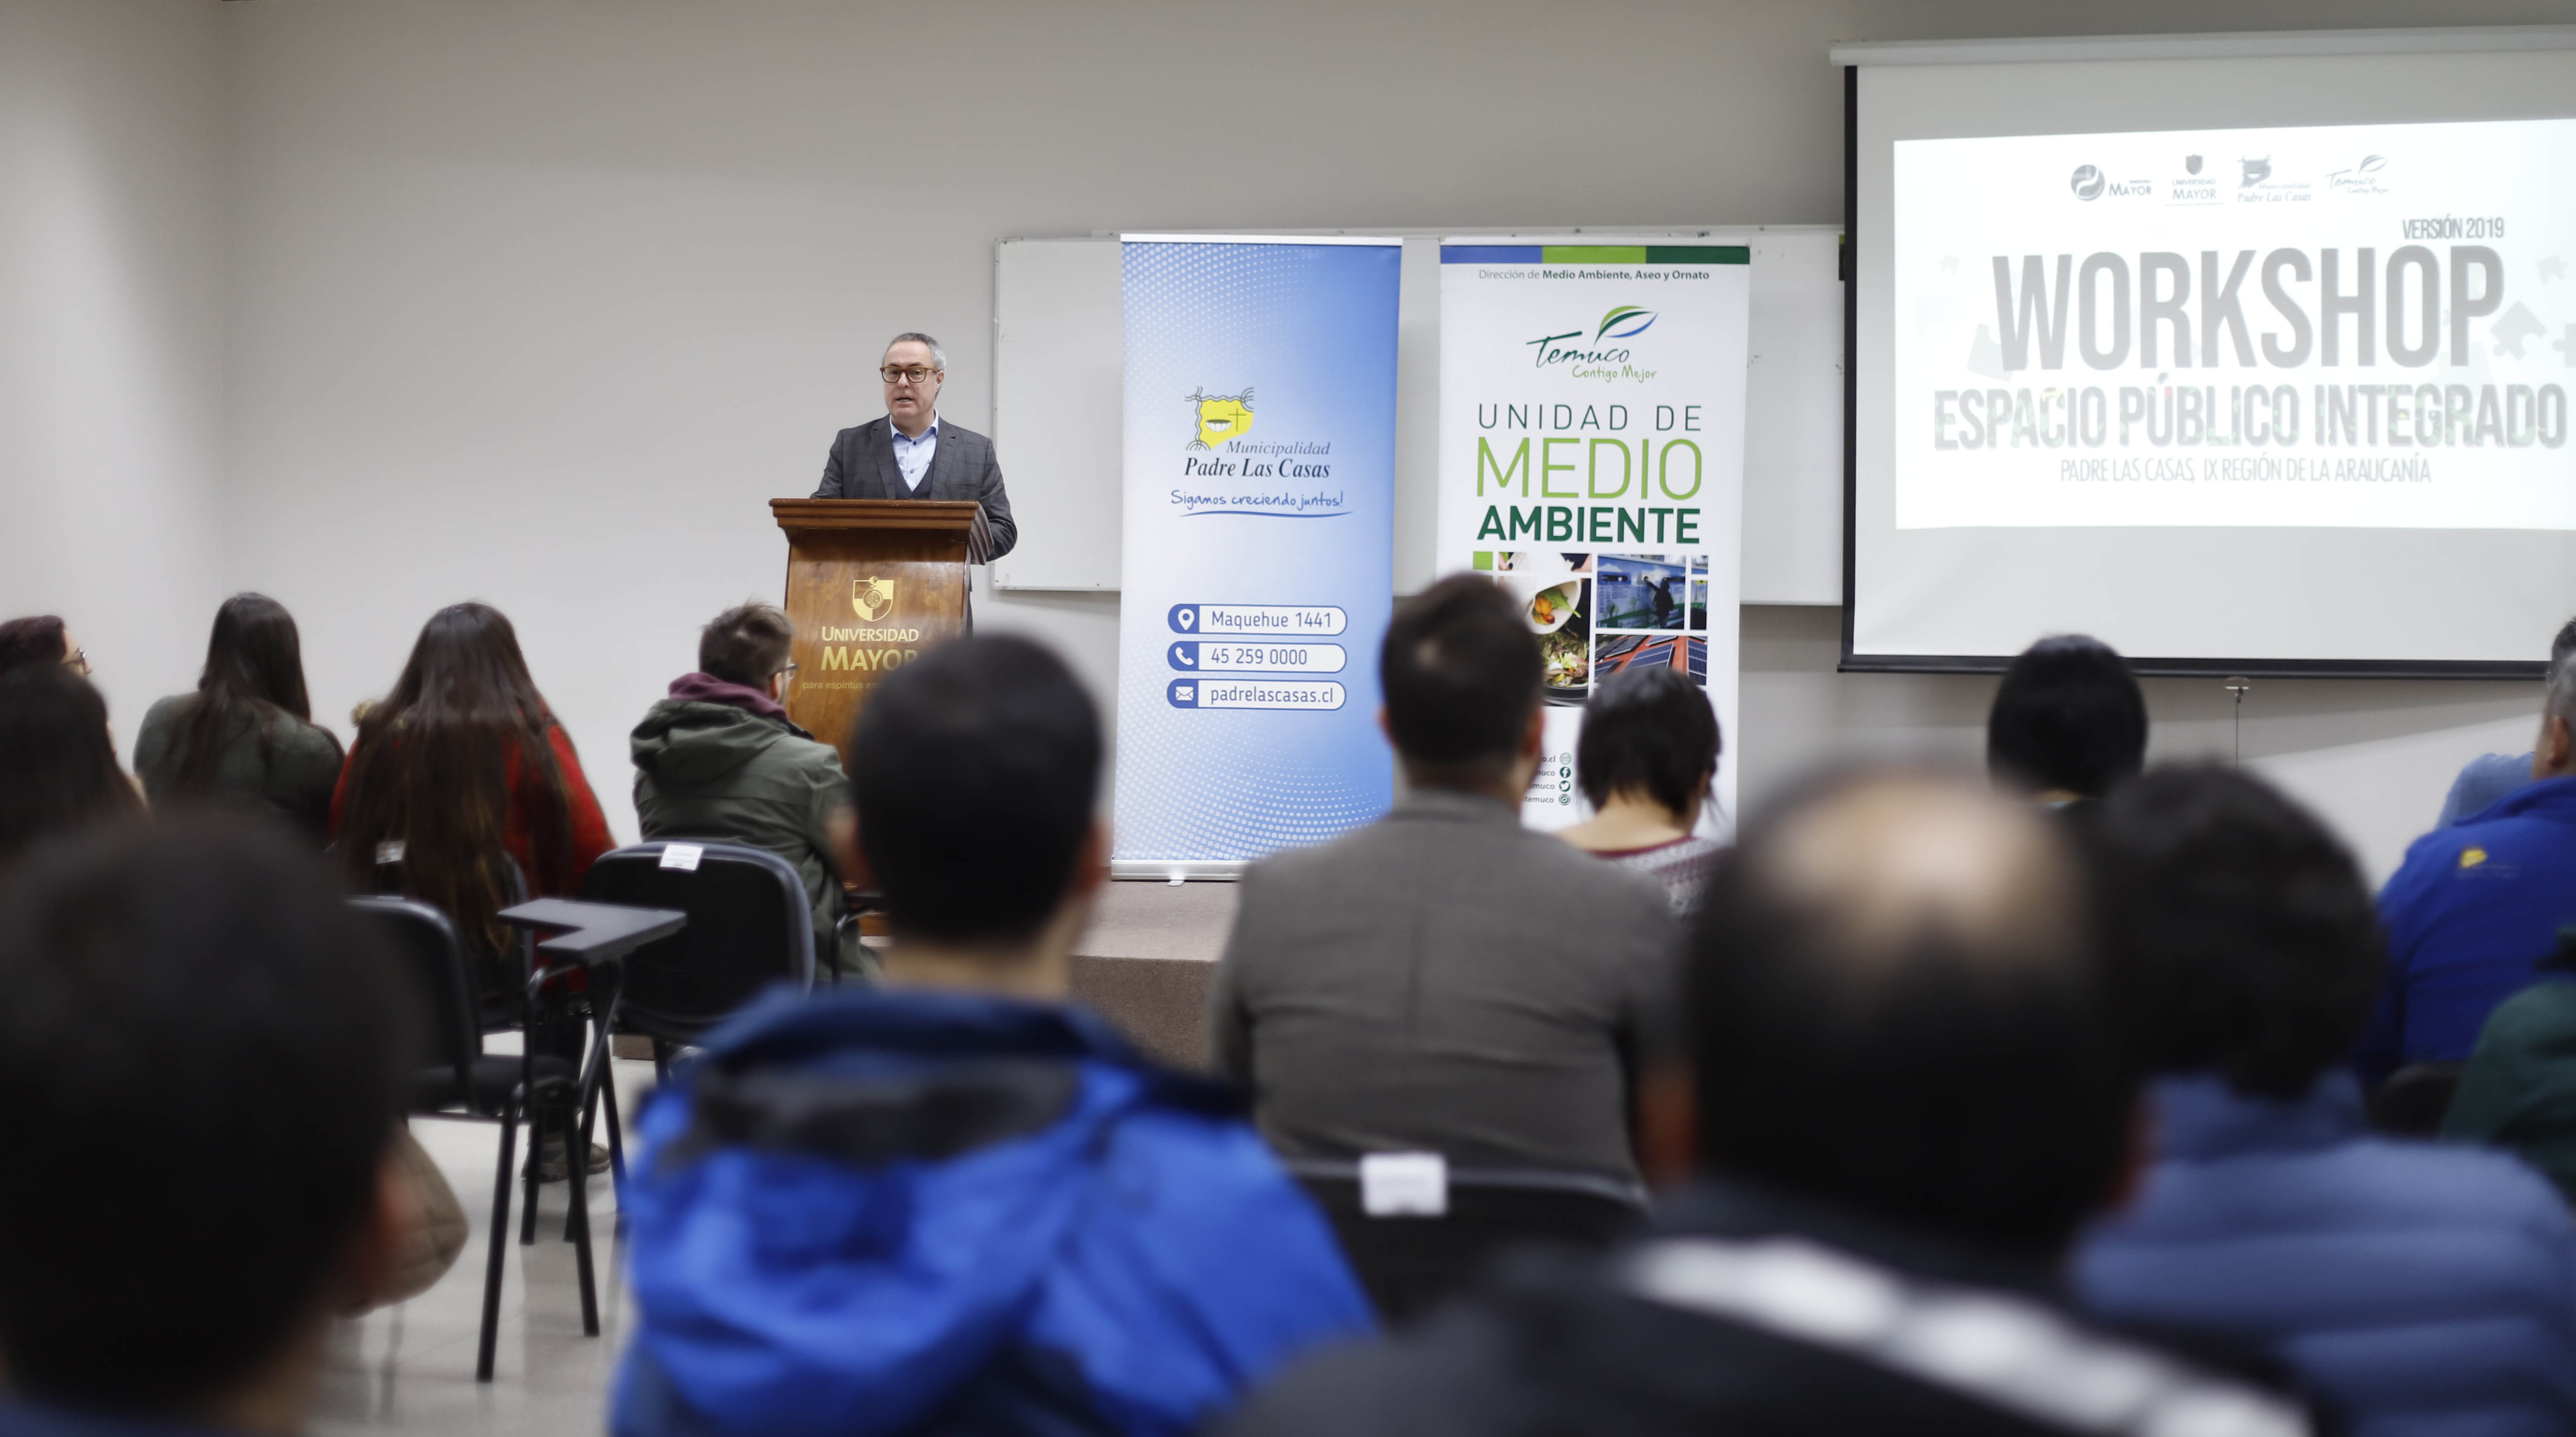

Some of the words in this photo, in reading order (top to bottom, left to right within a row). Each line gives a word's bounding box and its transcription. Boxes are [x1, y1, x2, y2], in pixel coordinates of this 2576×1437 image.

[2325, 169, 2375, 189] Temuco
[2109, 183, 2152, 196] MAYOR
[2172, 188, 2216, 199] MAYOR
[2237, 192, 2263, 202] Padre
[2267, 192, 2282, 202] Las
[2285, 192, 2311, 201] Casas
[2402, 213, 2463, 239] VERSIÓN
[2466, 217, 2505, 239] 2019
[1479, 269, 1525, 279] Dirección
[1527, 270, 1539, 279] de
[1542, 269, 1575, 279] Medio
[1578, 269, 1632, 281] Ambiente,
[1636, 270, 1661, 280] Aseo
[1664, 272, 1669, 282] y
[1672, 270, 1709, 280] Ornato
[1992, 244, 2505, 371] WORKSHOP
[1526, 331, 1630, 367] Temuco
[1572, 365, 1617, 382] Contigo
[1622, 365, 1657, 383] Mejor
[1478, 404, 1628, 430] UNIDAD
[1656, 405, 1702, 431] DE
[1934, 385, 2106, 450] ESPACIO
[2118, 372, 2299, 448] PÚBLICO
[2314, 382, 2567, 449] INTEGRADO
[1226, 440, 1331, 457] Municipalidad
[1184, 457, 1236, 477] Padre
[1241, 458, 1273, 477] Las
[1279, 458, 1331, 478] Casas
[1477, 437, 1702, 500] MEDIO
[2060, 458, 2108, 481] PADRE
[2112, 458, 2140, 481] LAS
[2145, 458, 2195, 484] CASAS,
[2204, 458, 2218, 481] IX
[2222, 452, 2281, 481] REGIÓN
[2286, 458, 2306, 481] DE
[2311, 458, 2330, 481] LA
[2334, 452, 2432, 482] ARAUCANÍA
[1171, 490, 1226, 510] Sigamos
[1231, 492, 1296, 507] creciendo
[1297, 491, 1344, 511] juntos!
[1477, 505, 1700, 544] AMBIENTE
[1212, 611, 1288, 630] Maquehue
[1295, 612, 1331, 628] 1441
[822, 626, 919, 642] UNIVERSIDAD
[1211, 648, 1229, 664] 45
[1236, 649, 1264, 664] 259
[1269, 649, 1307, 665] 0000
[826, 681, 863, 691] espíritus
[1211, 686, 1333, 704] padrelascasas.cl
